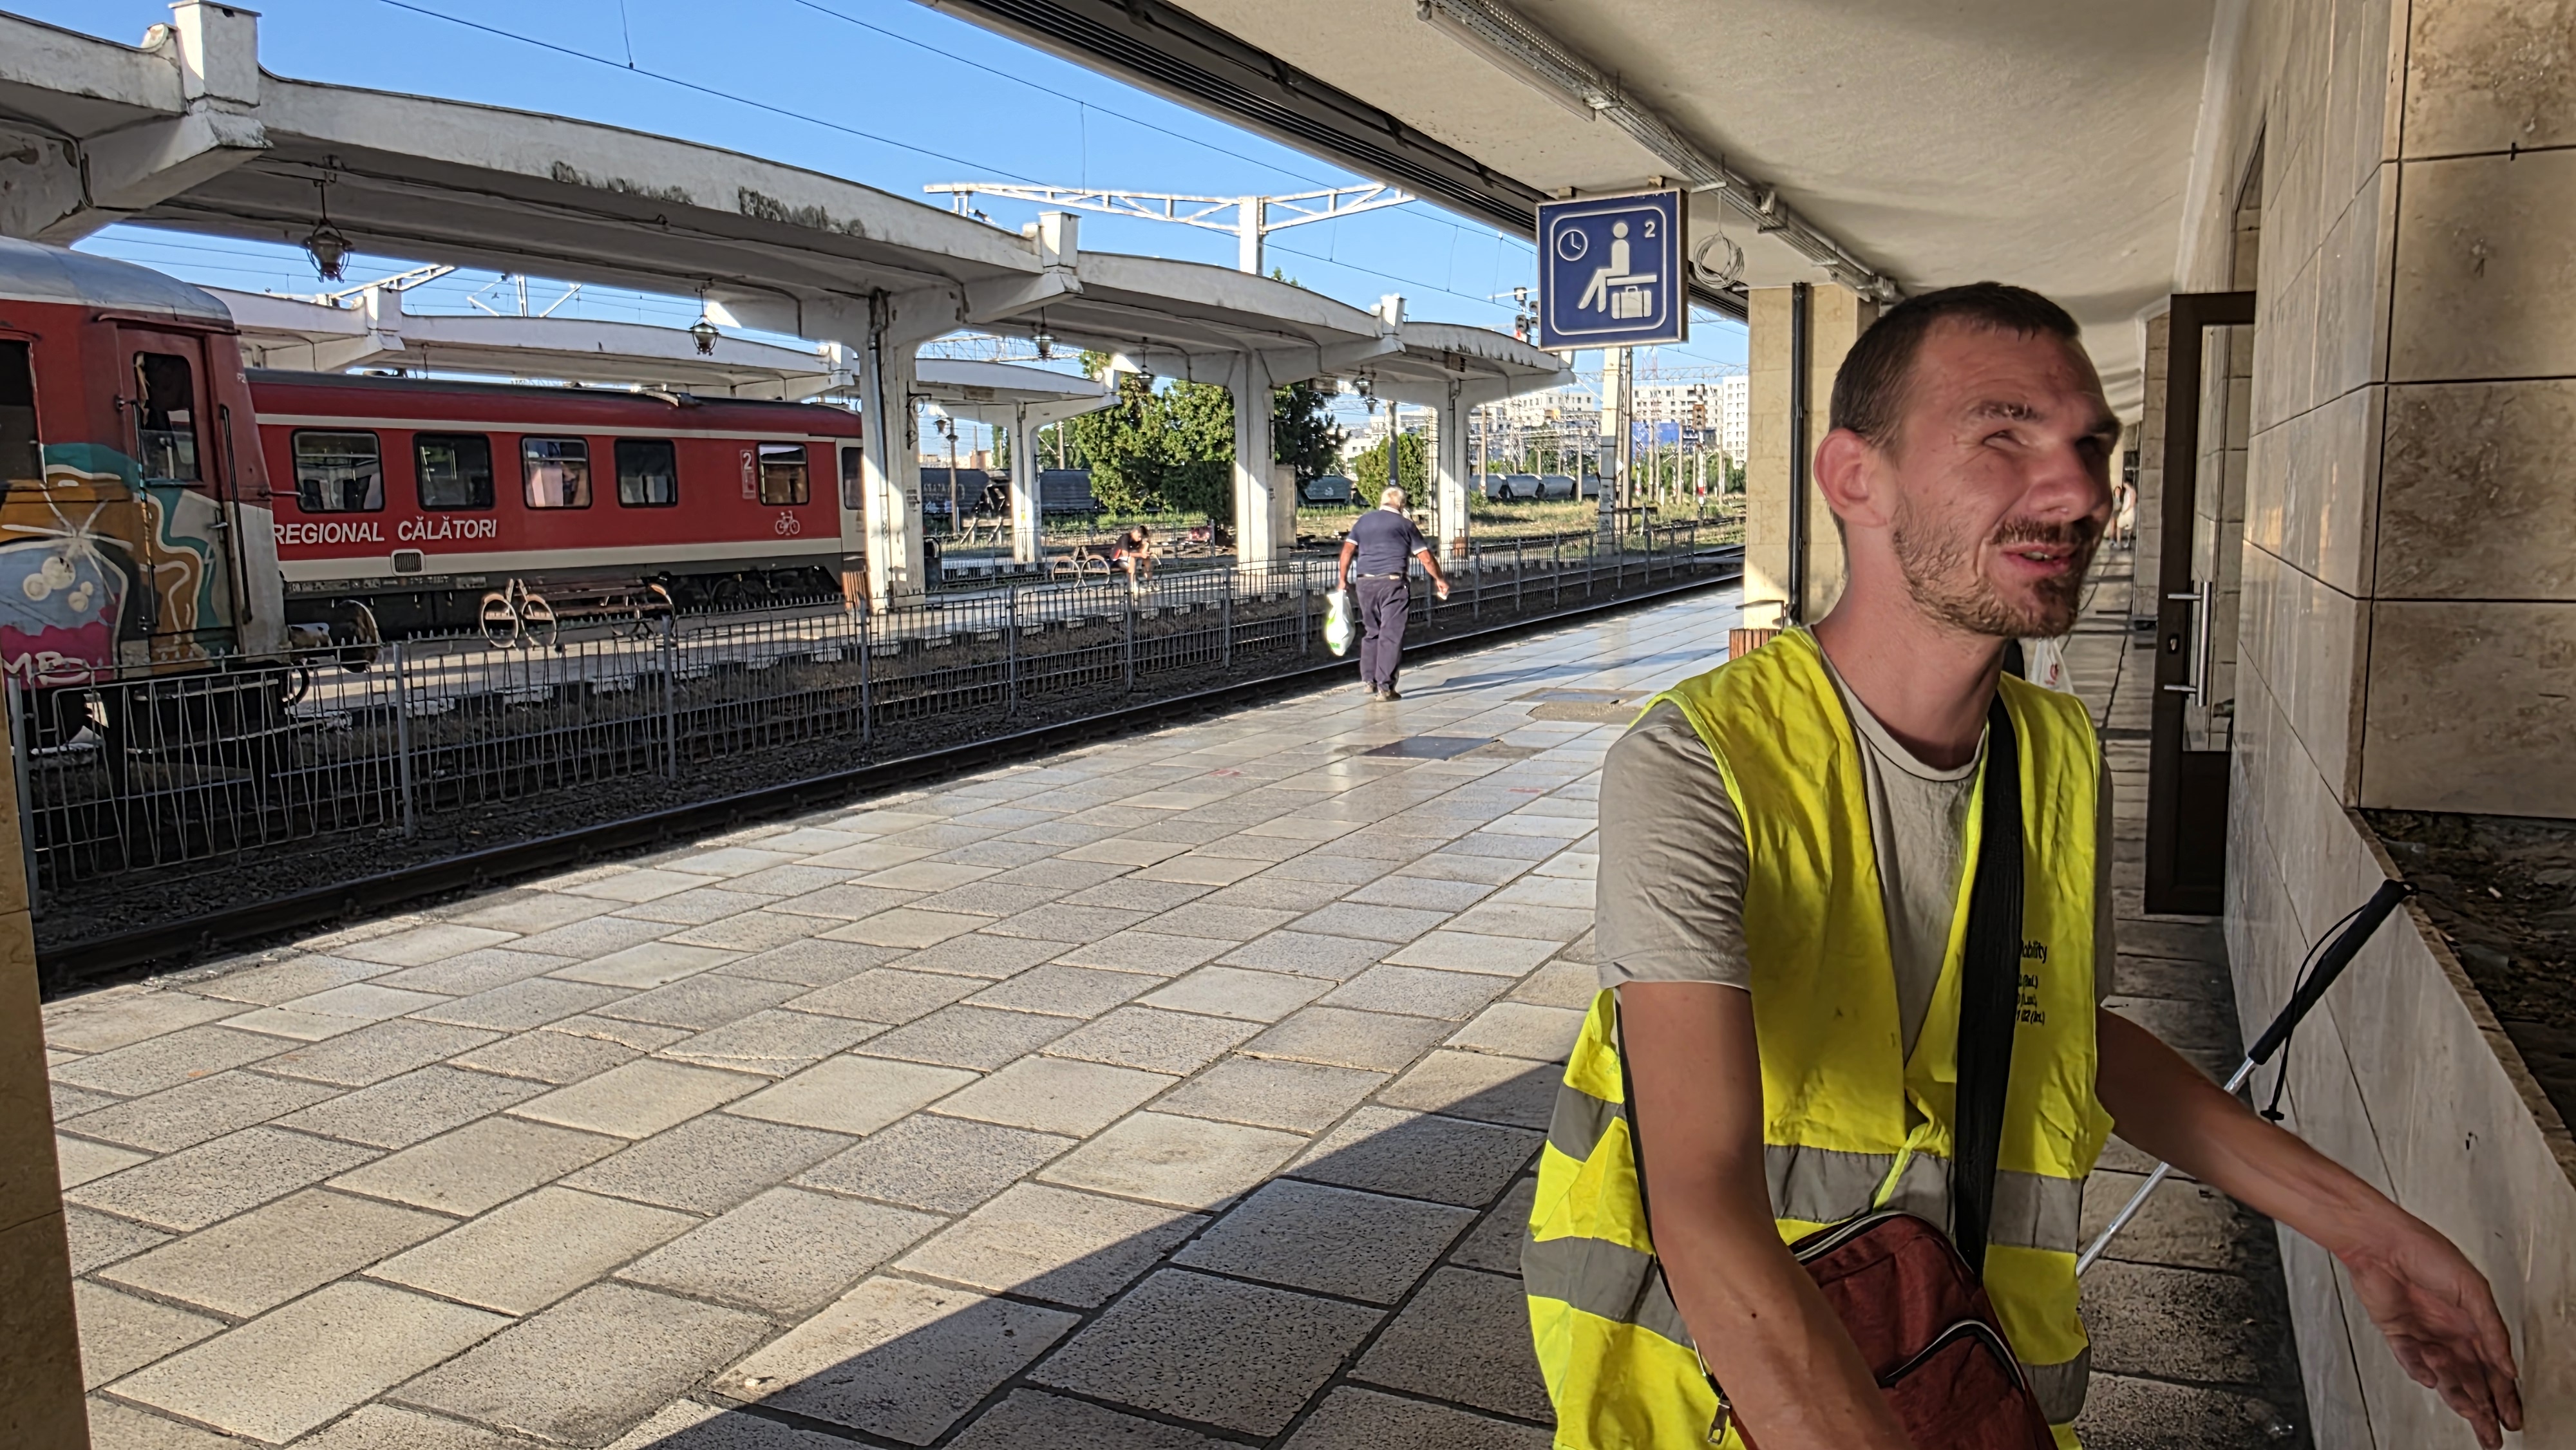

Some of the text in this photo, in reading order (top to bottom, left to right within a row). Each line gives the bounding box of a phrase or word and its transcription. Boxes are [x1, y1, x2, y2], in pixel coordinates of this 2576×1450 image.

[1644, 221, 1656, 238] 2
[743, 452, 752, 470] 2
[274, 516, 497, 545] REGIONAL CĂLĂTORI
